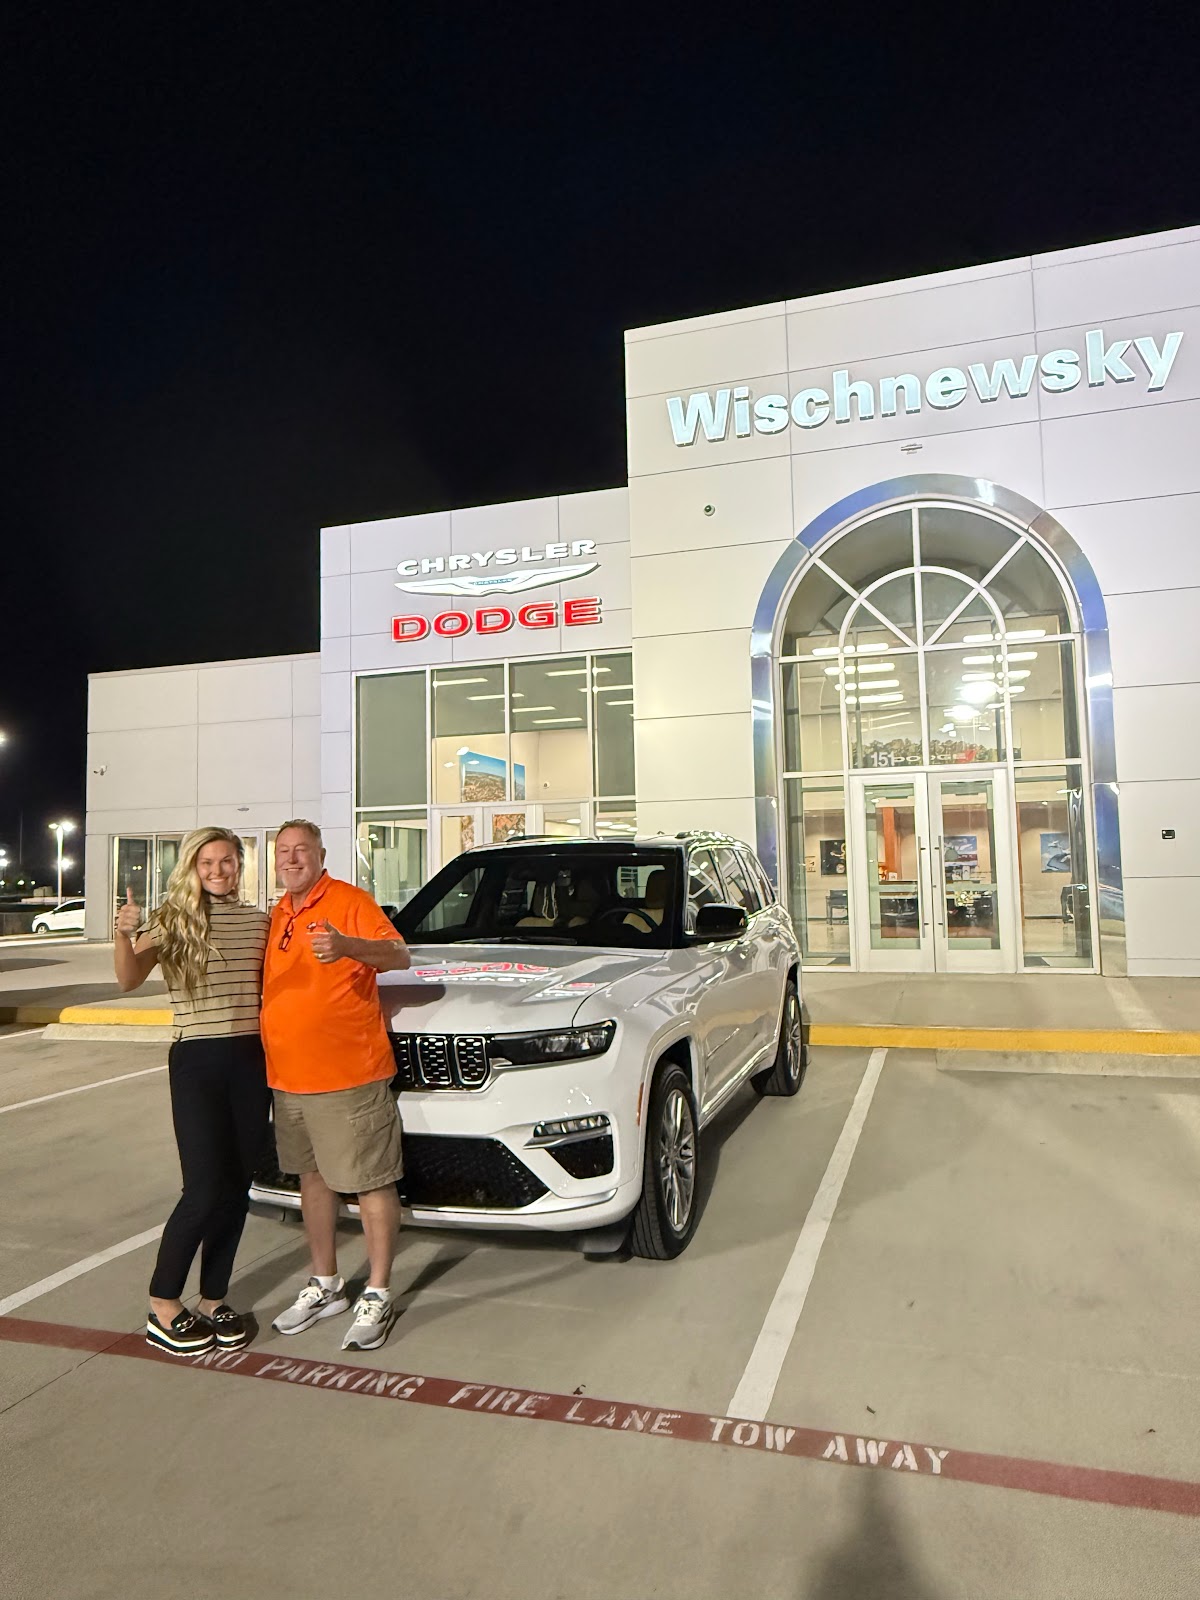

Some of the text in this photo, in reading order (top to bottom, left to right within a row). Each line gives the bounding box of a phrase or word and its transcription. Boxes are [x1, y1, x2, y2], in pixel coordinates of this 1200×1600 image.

[666, 329, 1184, 447] Wischnewsky
[396, 539, 597, 576] CHRYSLER
[391, 597, 602, 643] DODGE
[870, 751, 895, 767] 151
[192, 1350, 949, 1474] NO PARKING FIRE LANE TOW AWAY
